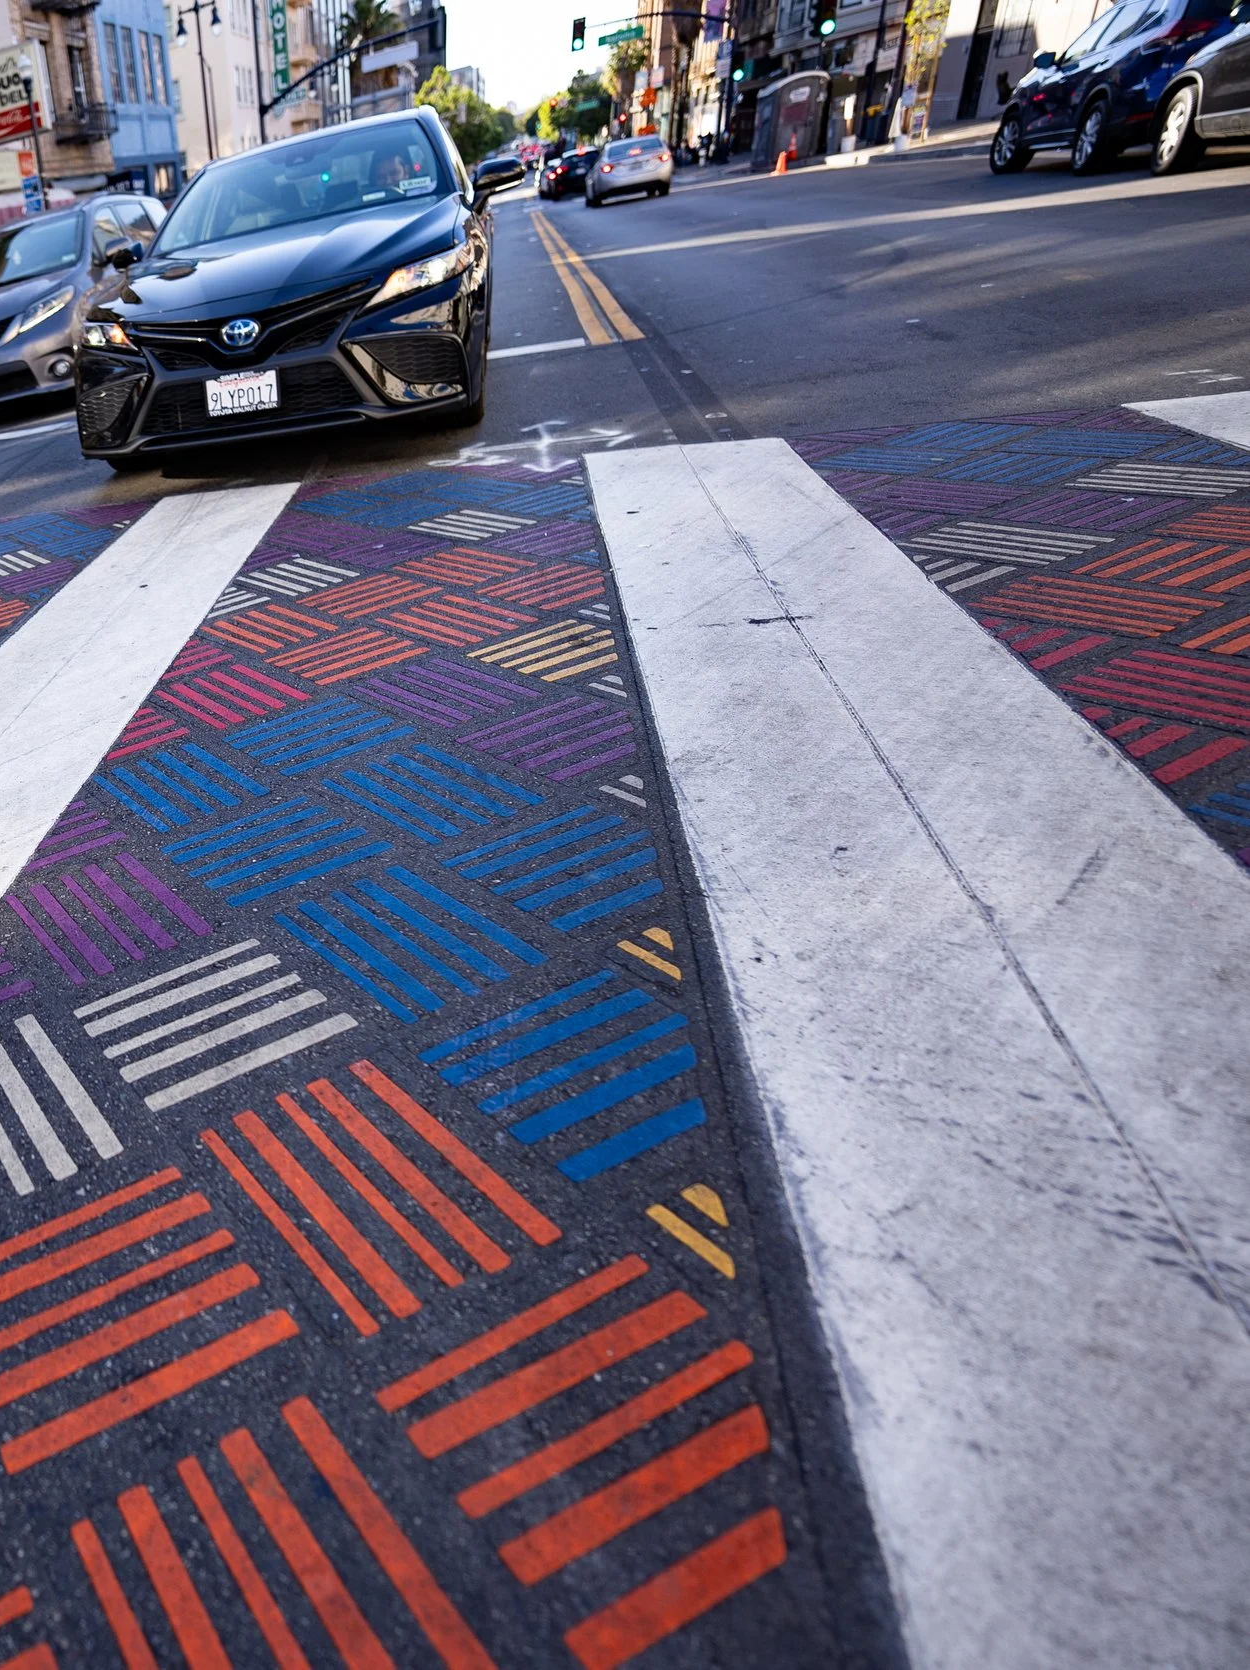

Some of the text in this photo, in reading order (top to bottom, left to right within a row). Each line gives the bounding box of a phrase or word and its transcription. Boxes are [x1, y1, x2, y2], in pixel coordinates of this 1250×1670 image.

[211, 384, 273, 411] 9LYP017
[209, 402, 278, 416] TOYOTA WALNUT CREEK
